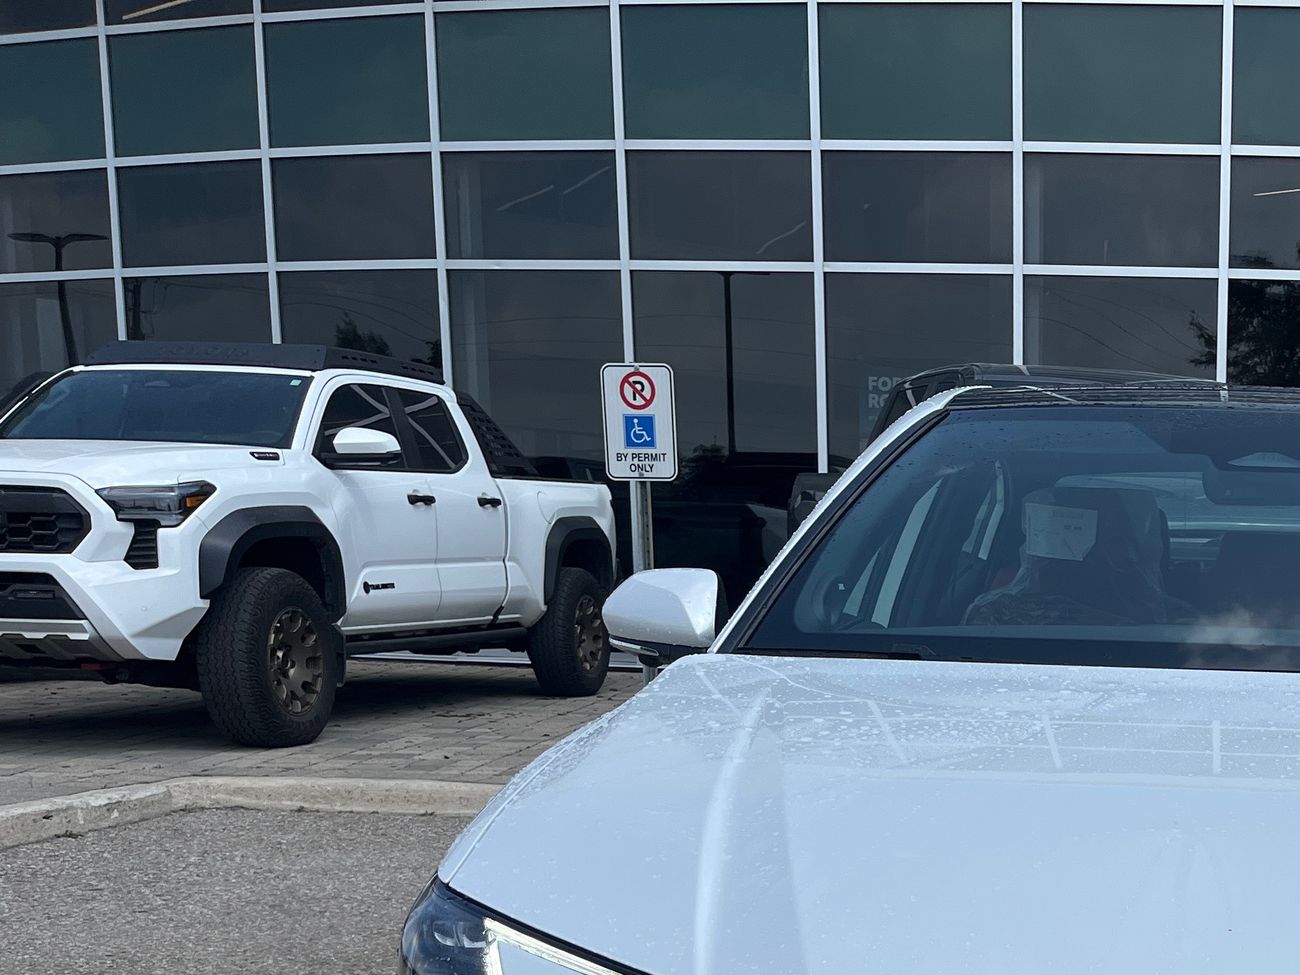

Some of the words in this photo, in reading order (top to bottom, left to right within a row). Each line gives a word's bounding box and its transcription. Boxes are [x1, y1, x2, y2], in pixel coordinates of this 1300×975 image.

[616, 453, 629, 462] BY
[631, 453, 667, 462] PERMIT
[629, 463, 654, 473] ONLY
